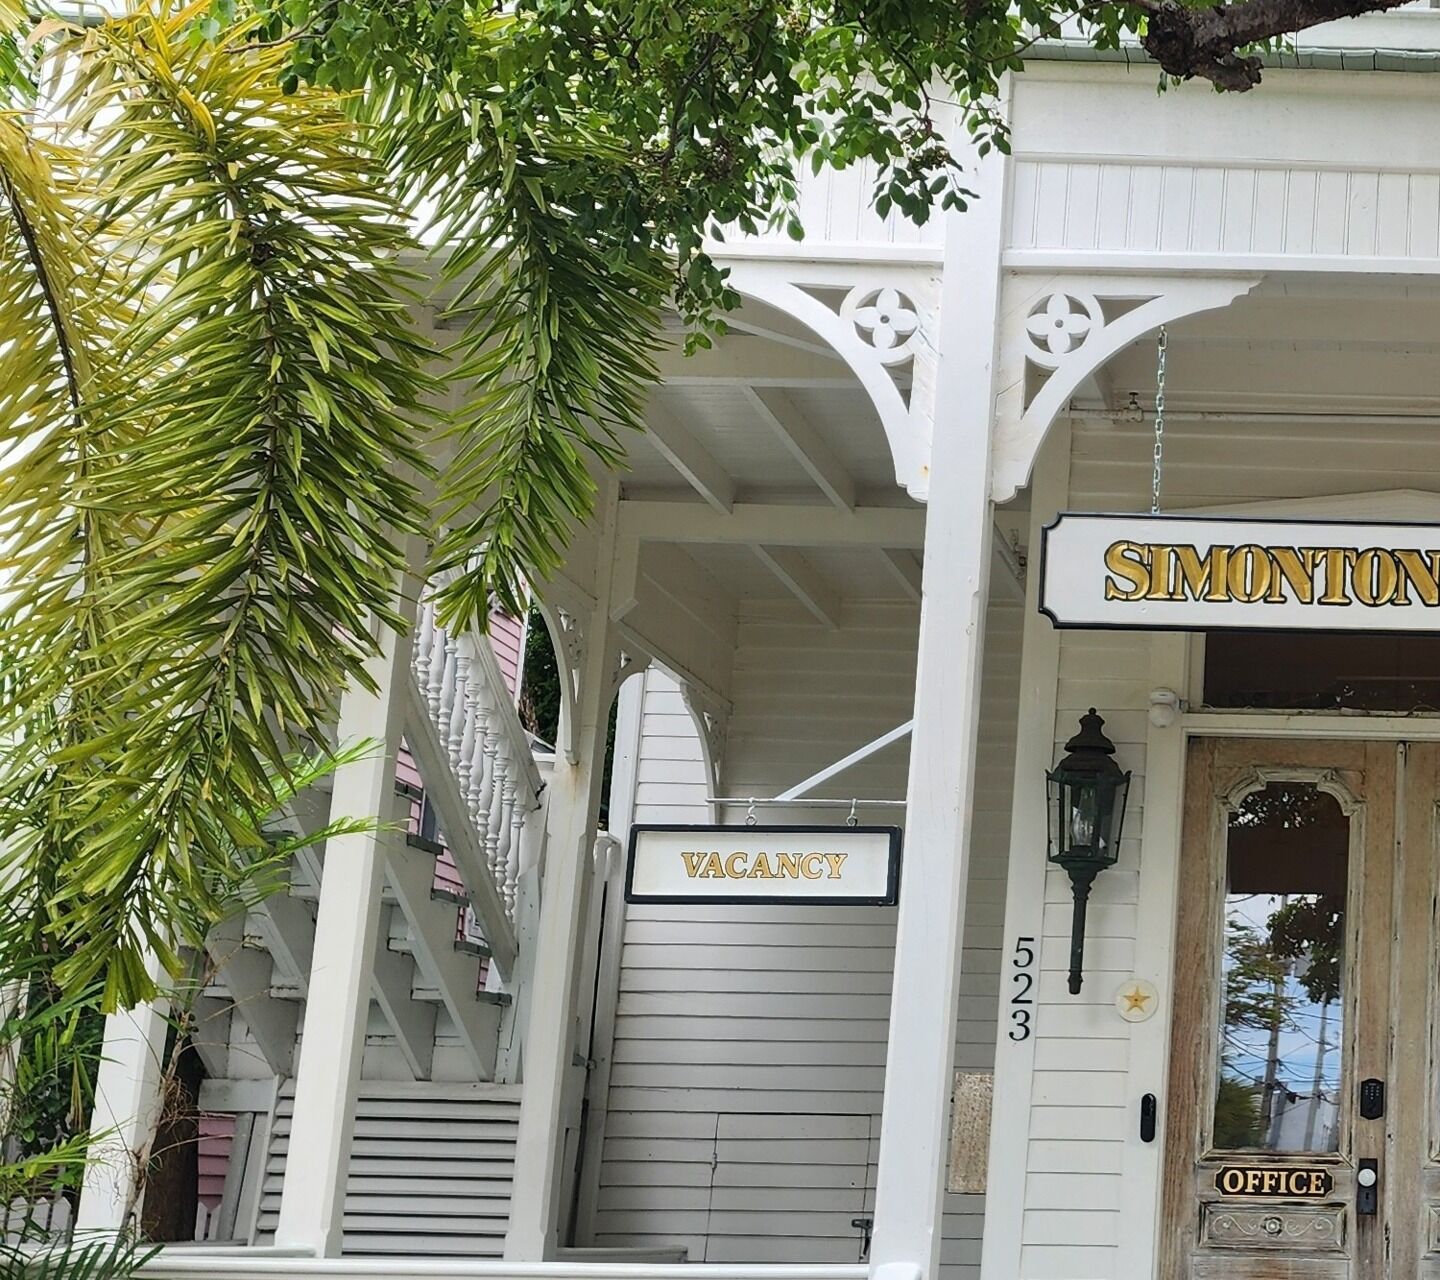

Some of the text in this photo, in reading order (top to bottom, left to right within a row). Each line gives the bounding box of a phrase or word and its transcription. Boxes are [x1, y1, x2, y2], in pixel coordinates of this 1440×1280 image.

[681, 851, 848, 880] VACANCY
[1009, 937, 1035, 1041] 523
[1223, 1169, 1325, 1194] OFFICE
